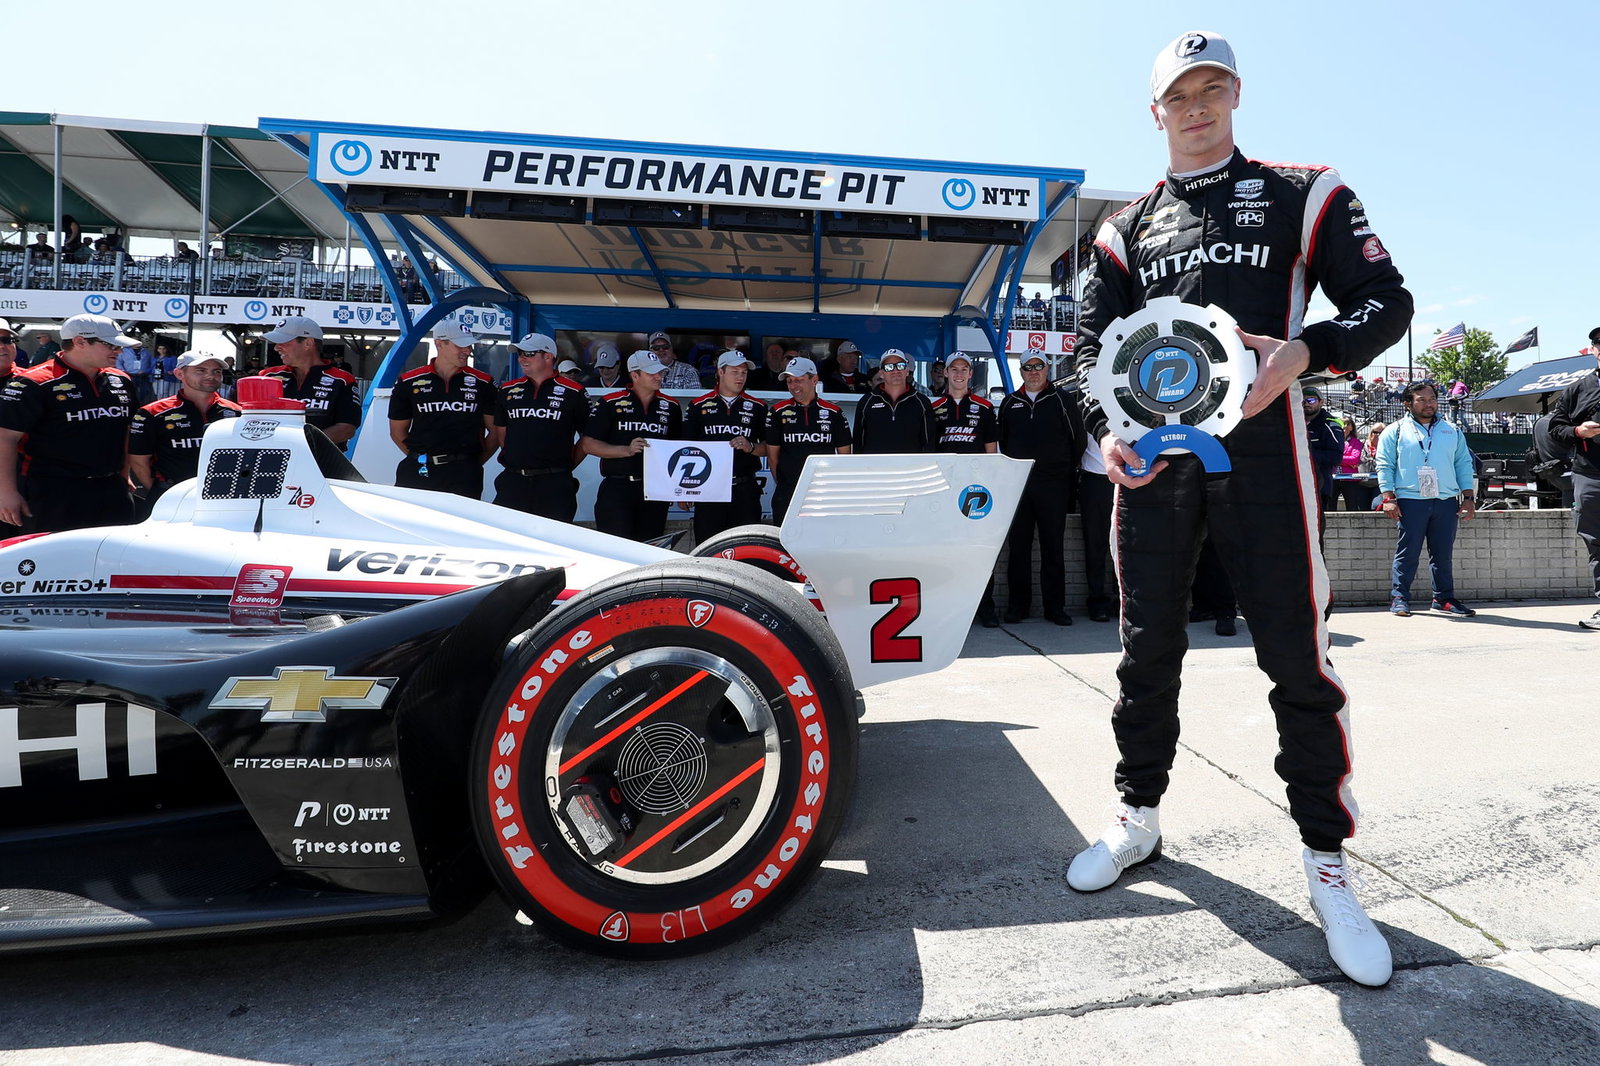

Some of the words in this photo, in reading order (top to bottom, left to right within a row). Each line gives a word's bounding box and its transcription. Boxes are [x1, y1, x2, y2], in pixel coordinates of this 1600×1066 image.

[380, 150, 440, 172] NTT
[483, 150, 826, 200] PERFORMANCE
[838, 172, 905, 205] PIT
[1185, 171, 1230, 192] HITACHI
[982, 187, 1030, 207] NTT
[1228, 200, 1269, 209] verizon
[1238, 212, 1262, 224] PPG
[1138, 242, 1270, 287] HITACHI
[112, 299, 147, 312] NTT
[193, 303, 228, 315] NTT
[271, 305, 305, 317] NTT
[1165, 350, 1179, 358] NTT
[1390, 370, 1416, 379] Sectin
[1160, 388, 1185, 397] AWARD
[417, 401, 478, 413] HITACHI
[66, 406, 129, 421] HITACH
[508, 407, 562, 420] HITACHI
[618, 421, 668, 435] HITACHI
[704, 425, 752, 437] HITACHI
[945, 426, 975, 434] TEAM
[783, 432, 832, 443] HITACHI
[939, 434, 976, 444] PENSKE
[1161, 433, 1187, 442] DETROIT
[327, 548, 547, 579] verizon
[235, 595, 279, 606] Speedway
[870, 577, 923, 664] 2
[234, 758, 345, 769] FITZGERALD
[364, 757, 392, 769] USA
[358, 808, 391, 821] NTT
[292, 838, 402, 856] Firestone
